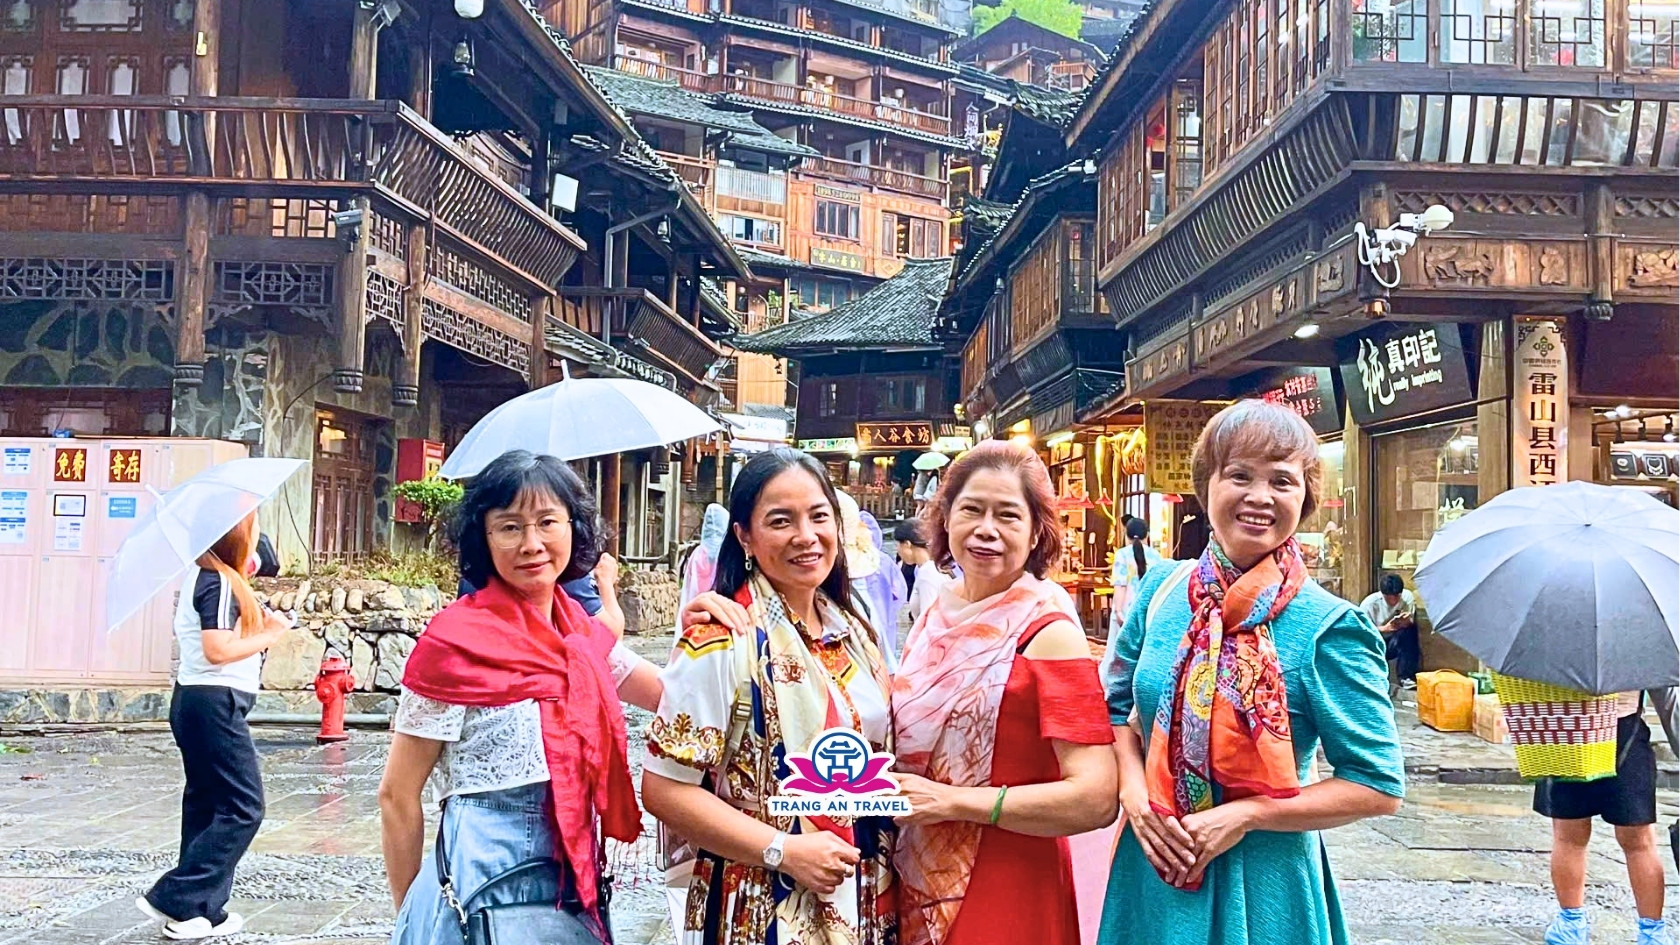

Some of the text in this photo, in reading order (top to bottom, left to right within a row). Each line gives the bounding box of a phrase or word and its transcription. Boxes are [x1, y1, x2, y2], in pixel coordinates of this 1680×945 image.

[1528, 372, 1558, 486] 雷山县西
[55, 450, 86, 480] 免费
[110, 451, 140, 481] 寄存
